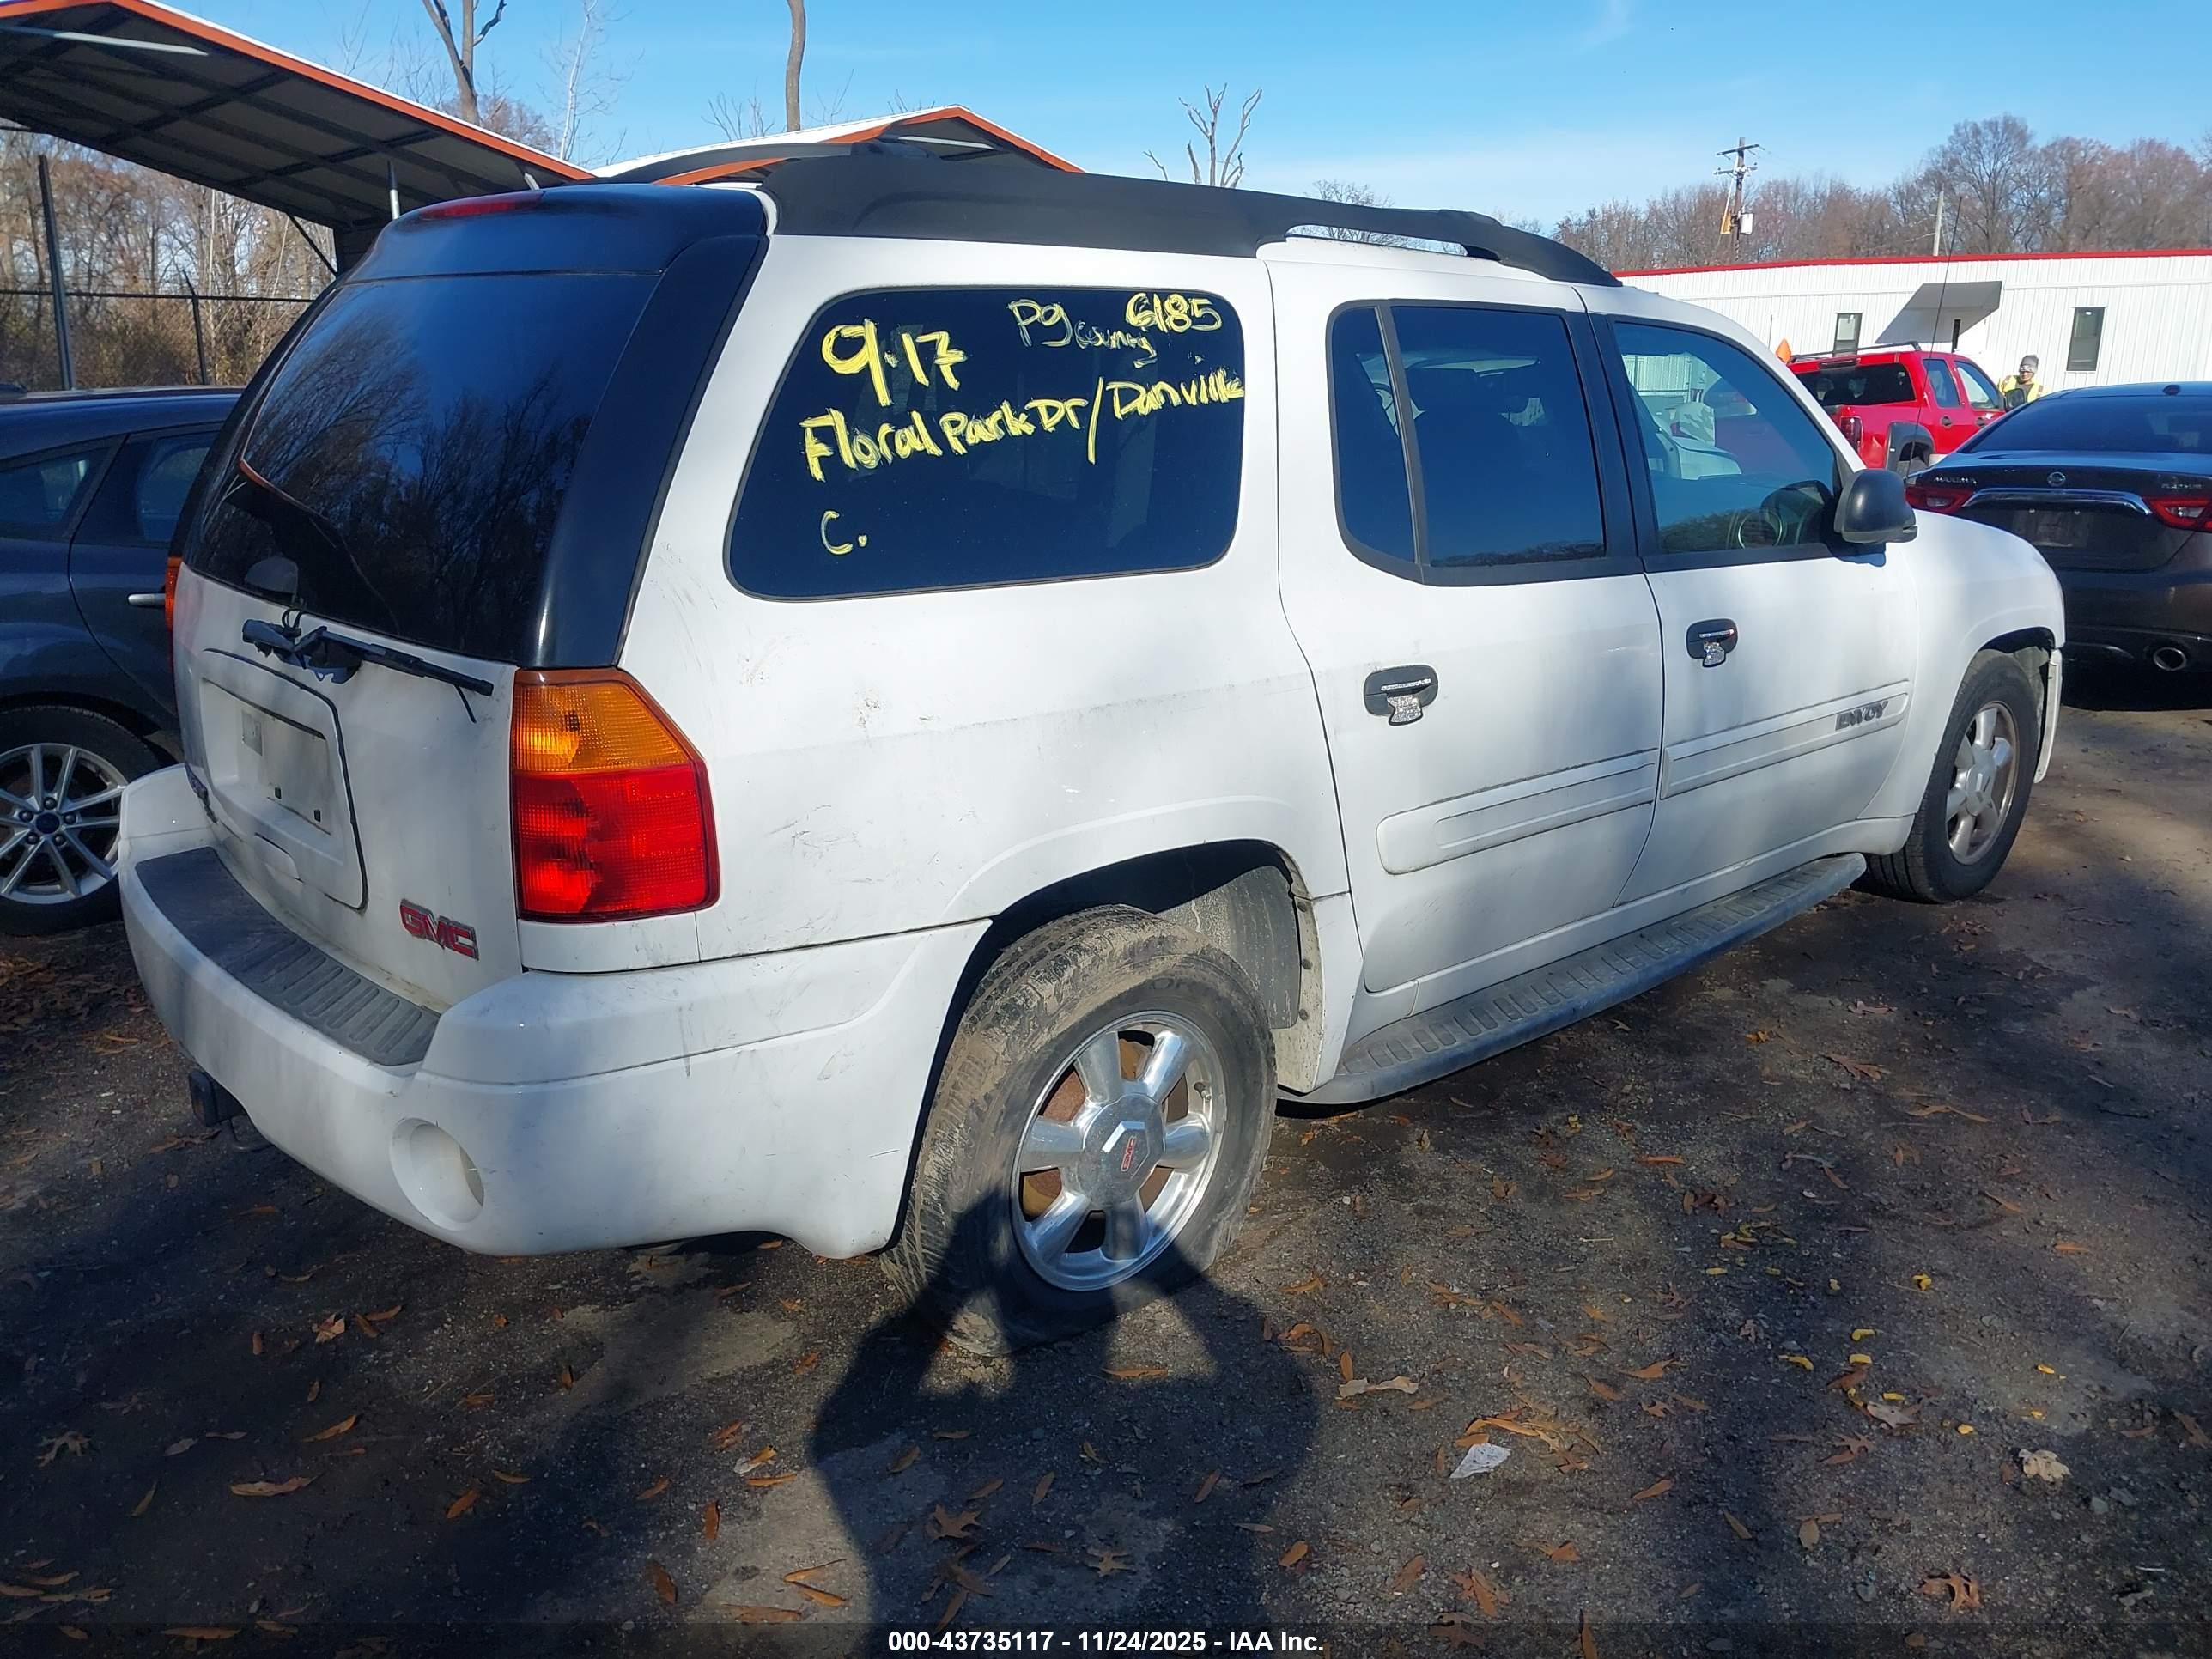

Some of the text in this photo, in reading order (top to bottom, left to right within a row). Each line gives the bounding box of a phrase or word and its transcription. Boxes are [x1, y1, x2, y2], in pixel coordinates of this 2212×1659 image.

[1125, 293, 1222, 333] 6185
[799, 408, 943, 482] Floral
[939, 400, 1036, 455] Park
[821, 510, 868, 555] C.
[399, 898, 479, 961] GMC
[1121, 1135, 1137, 1172] GMC
